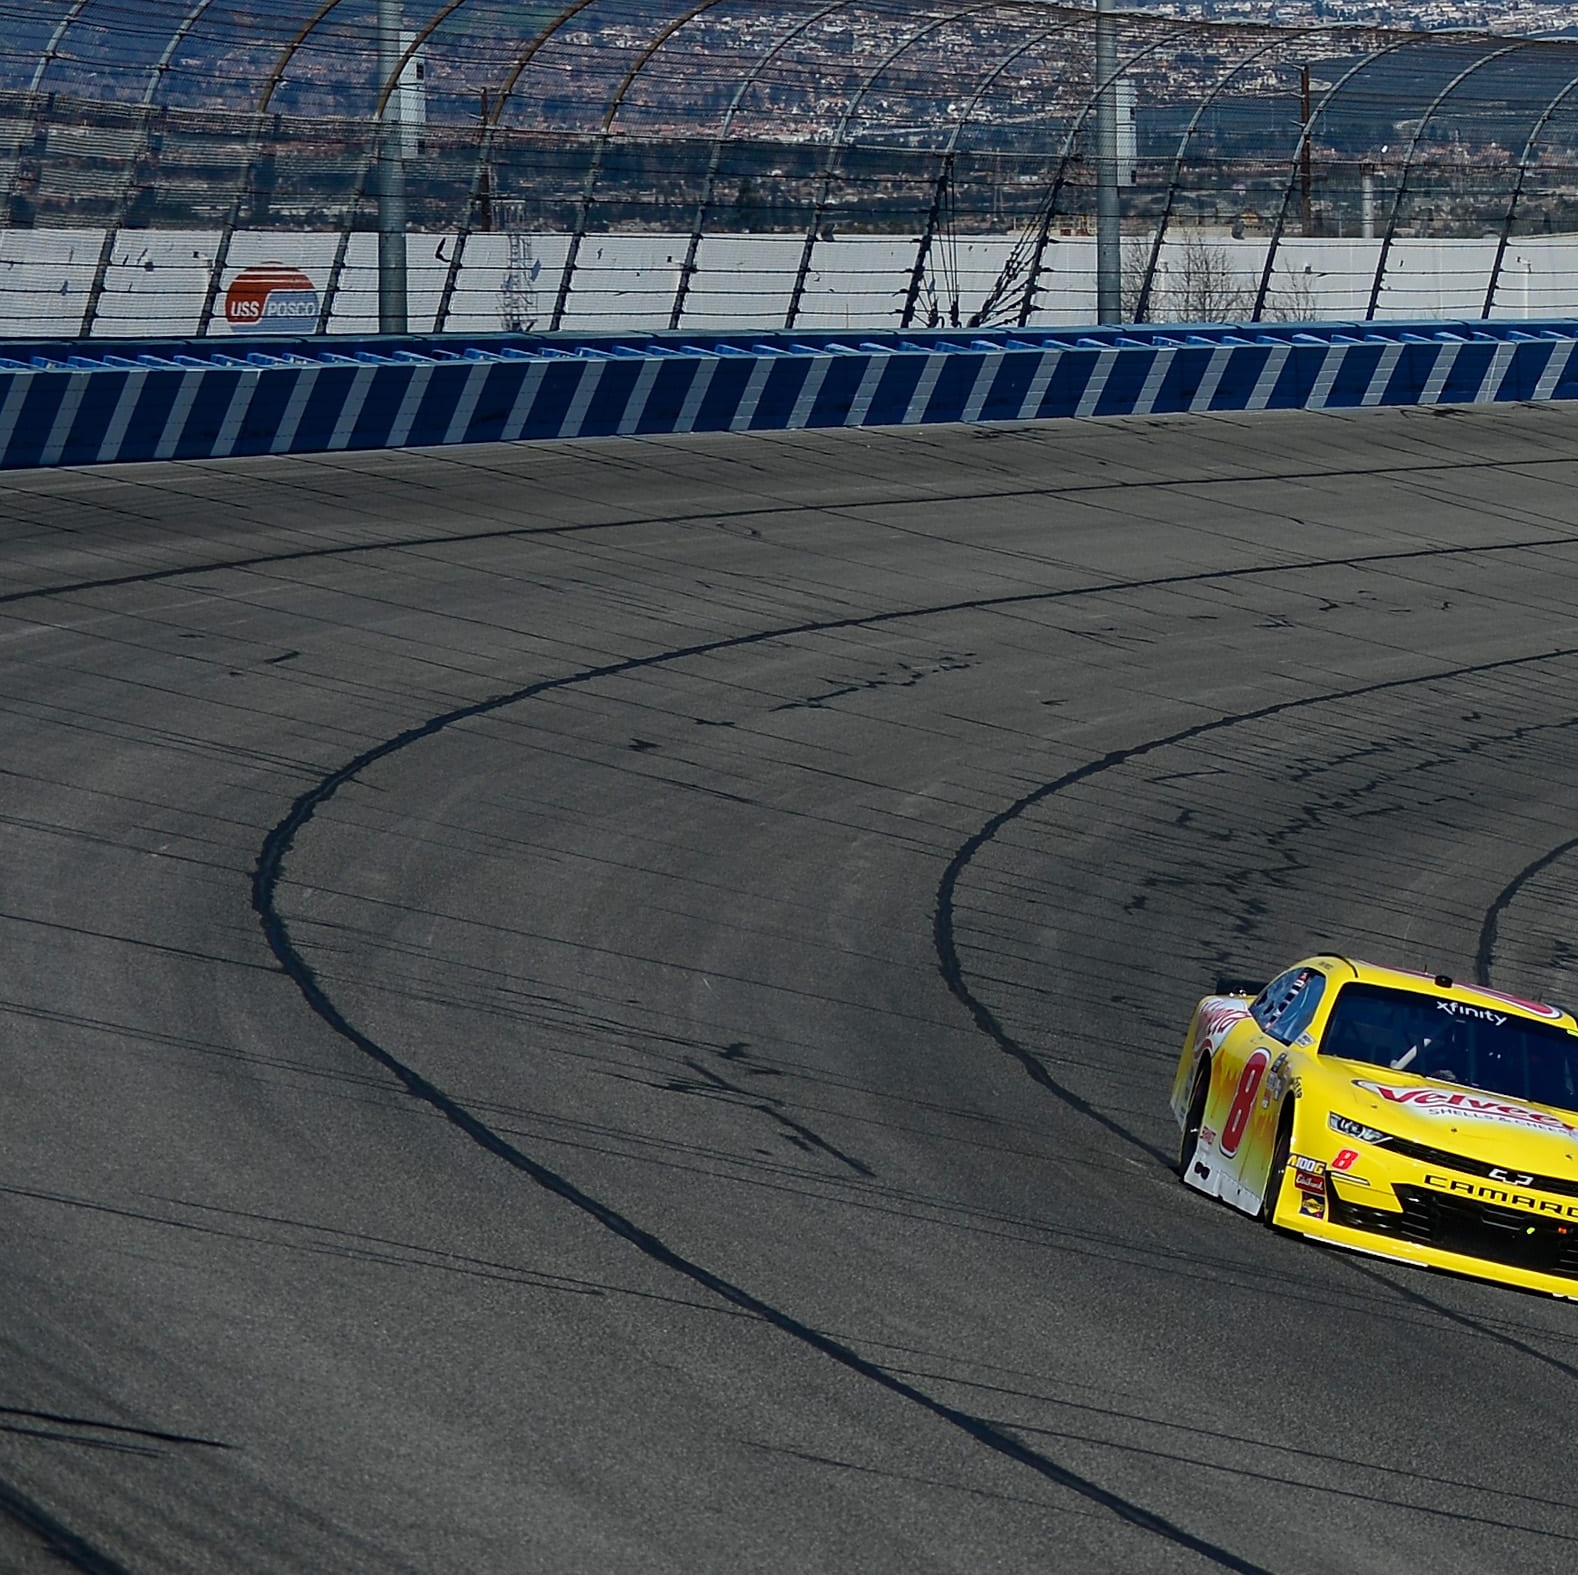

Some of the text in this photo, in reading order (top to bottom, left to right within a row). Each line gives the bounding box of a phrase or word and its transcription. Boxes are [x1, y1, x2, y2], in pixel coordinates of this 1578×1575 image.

[231, 301, 316, 317] USS POSCO
[1436, 1001, 1508, 1026] xfinity
[1220, 1048, 1271, 1158] 8
[1331, 1149, 1359, 1171] 8
